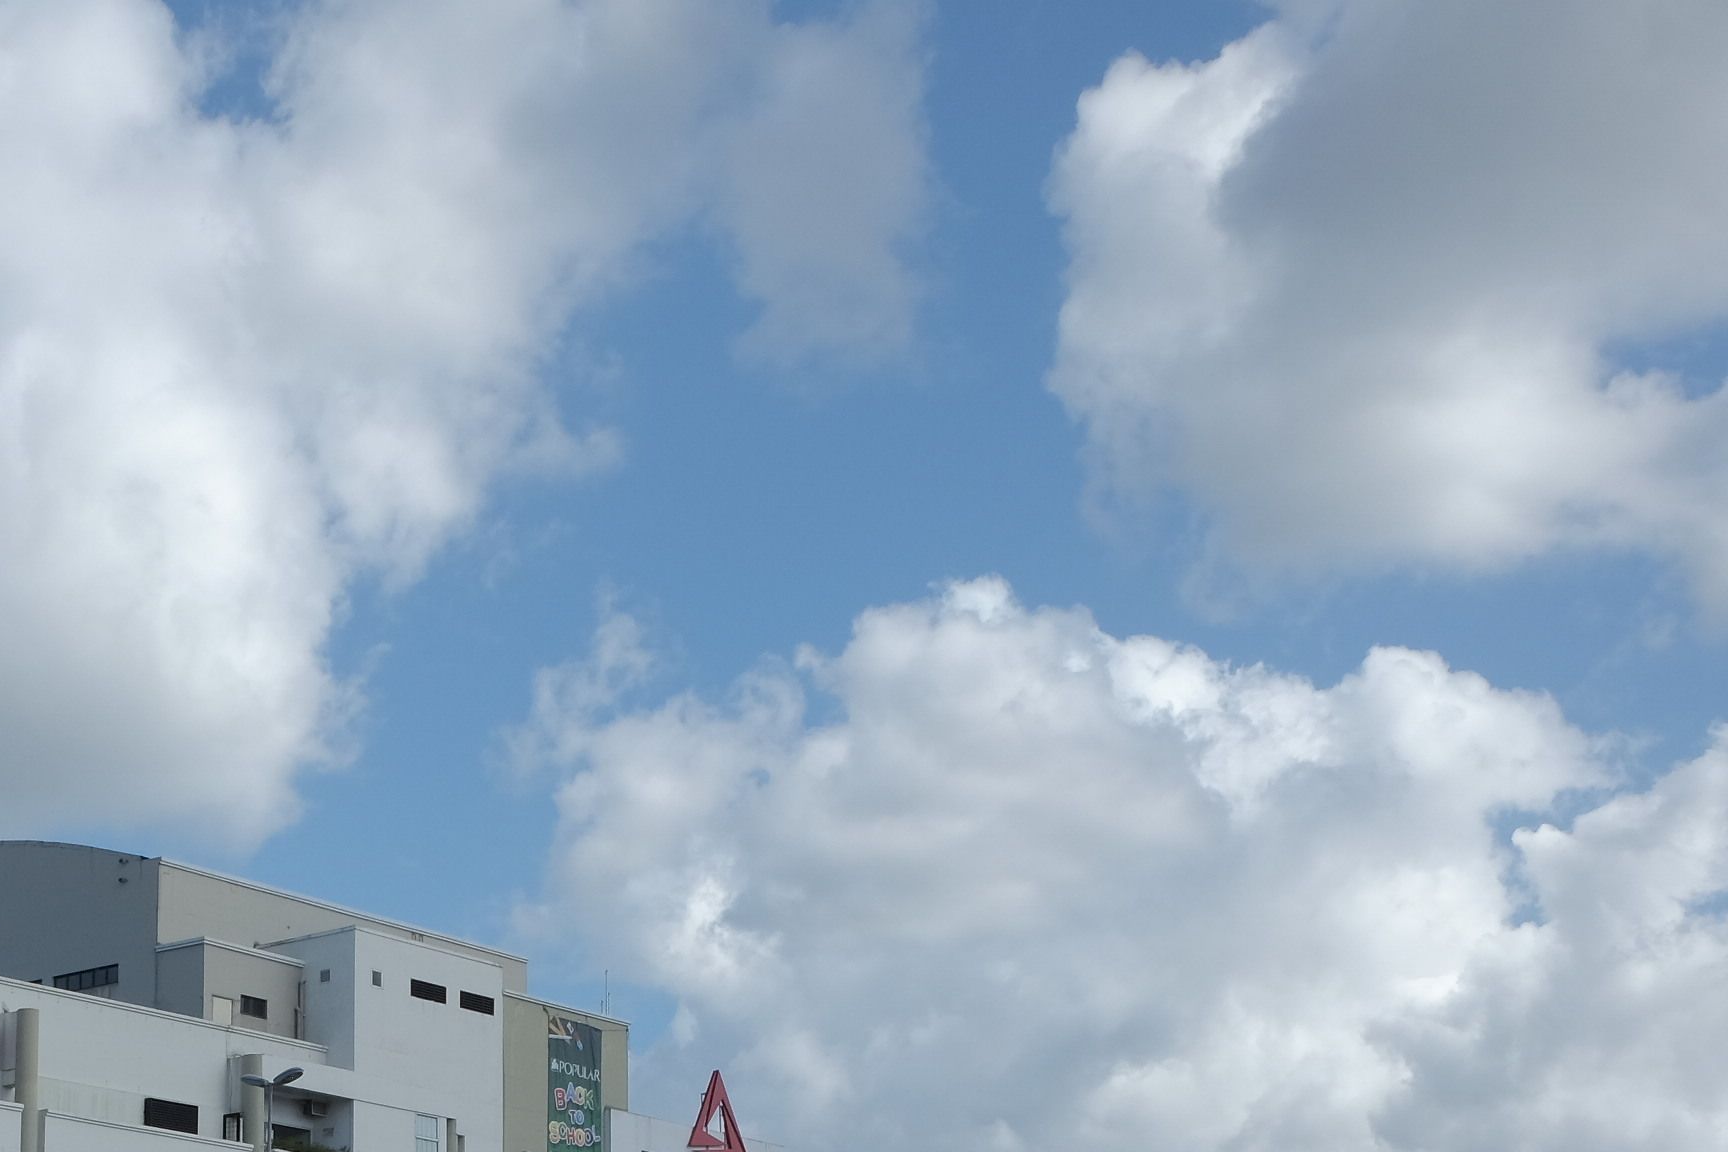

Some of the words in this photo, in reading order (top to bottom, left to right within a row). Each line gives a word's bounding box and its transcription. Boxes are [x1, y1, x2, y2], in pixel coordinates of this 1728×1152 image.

[559, 1060, 600, 1082] POPULAR
[554, 1082, 594, 1110] BACK
[569, 1110, 584, 1125] TO
[549, 1121, 600, 1147] SCHOOL
